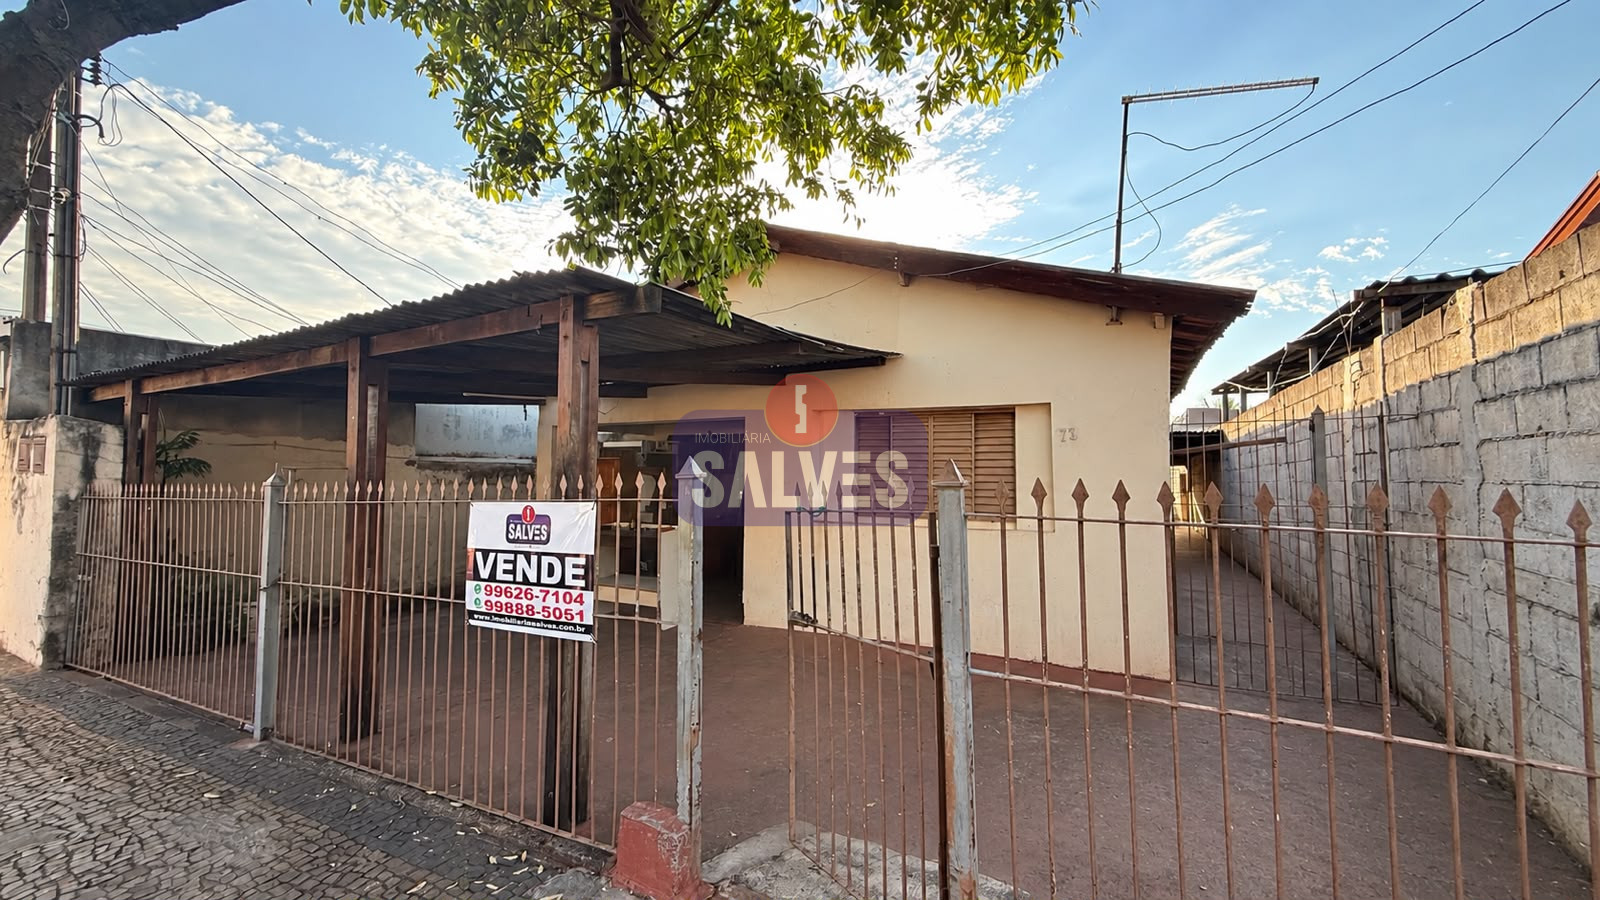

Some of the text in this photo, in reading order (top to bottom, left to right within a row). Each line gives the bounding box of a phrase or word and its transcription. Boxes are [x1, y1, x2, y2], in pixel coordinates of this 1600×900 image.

[1058, 427, 1078, 443] 73
[508, 523, 548, 541] SALVES
[475, 551, 587, 588] VENDE
[484, 584, 585, 606] 99626-7104
[484, 599, 585, 623] 99888-5051
